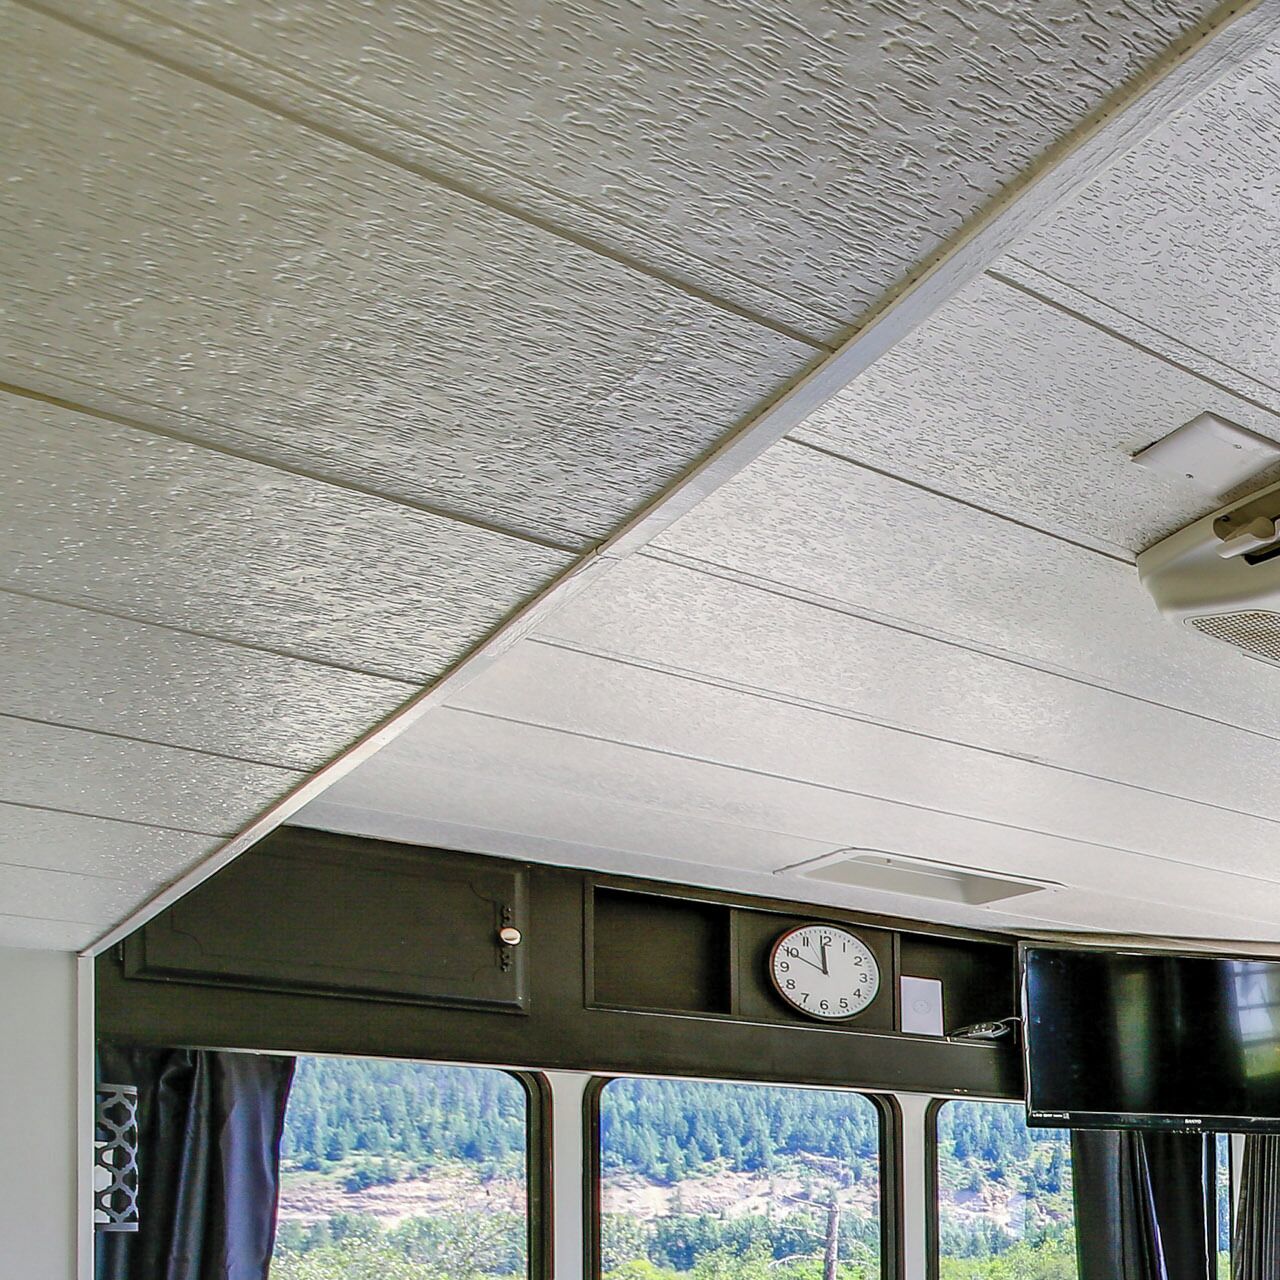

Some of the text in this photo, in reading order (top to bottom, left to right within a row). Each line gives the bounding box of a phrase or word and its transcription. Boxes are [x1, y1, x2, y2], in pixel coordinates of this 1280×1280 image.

[802, 936, 809, 947] 11
[820, 935, 832, 947] 12
[785, 946, 799, 958] 10
[842, 942, 846, 953] 1
[780, 961, 790, 973] 9
[854, 956, 863, 967] 2
[859, 973, 868, 983] 3
[786, 979, 796, 990] 8
[800, 992, 810, 1004] 7
[853, 988, 862, 999] 4
[820, 1000, 829, 1011] 6
[839, 998, 848, 1009] 5
